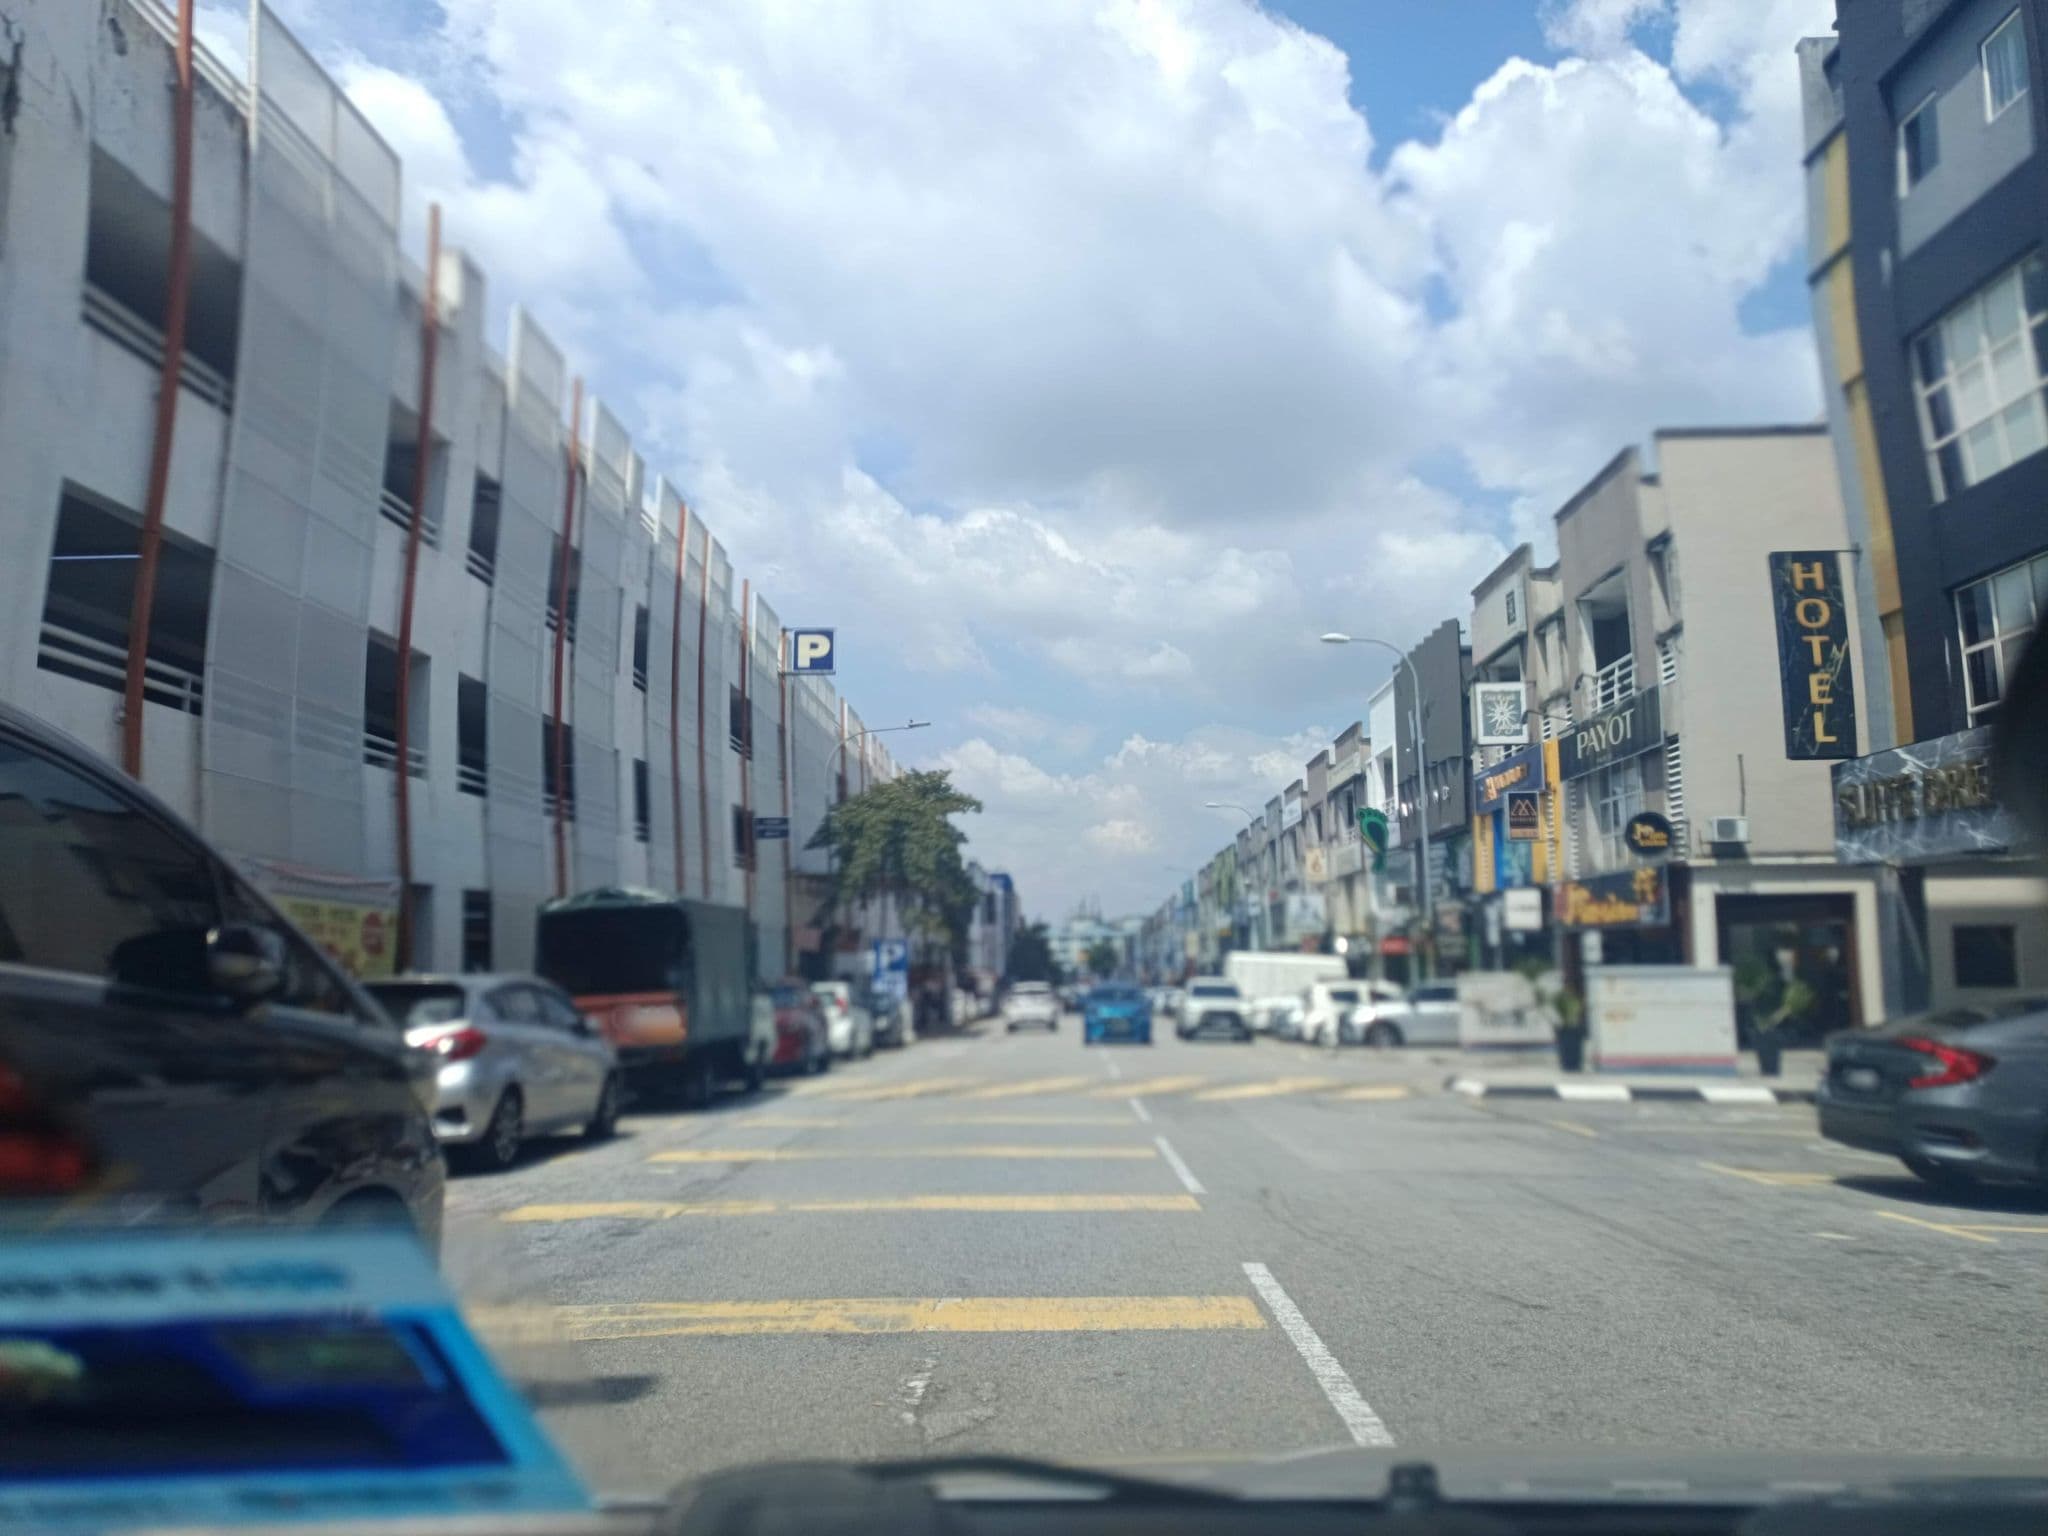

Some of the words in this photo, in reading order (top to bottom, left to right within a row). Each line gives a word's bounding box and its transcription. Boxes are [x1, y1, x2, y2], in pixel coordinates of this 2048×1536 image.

[797, 634, 831, 668] P
[1793, 561, 1837, 742] HOTEL
[1577, 708, 1635, 759] PAYOT
